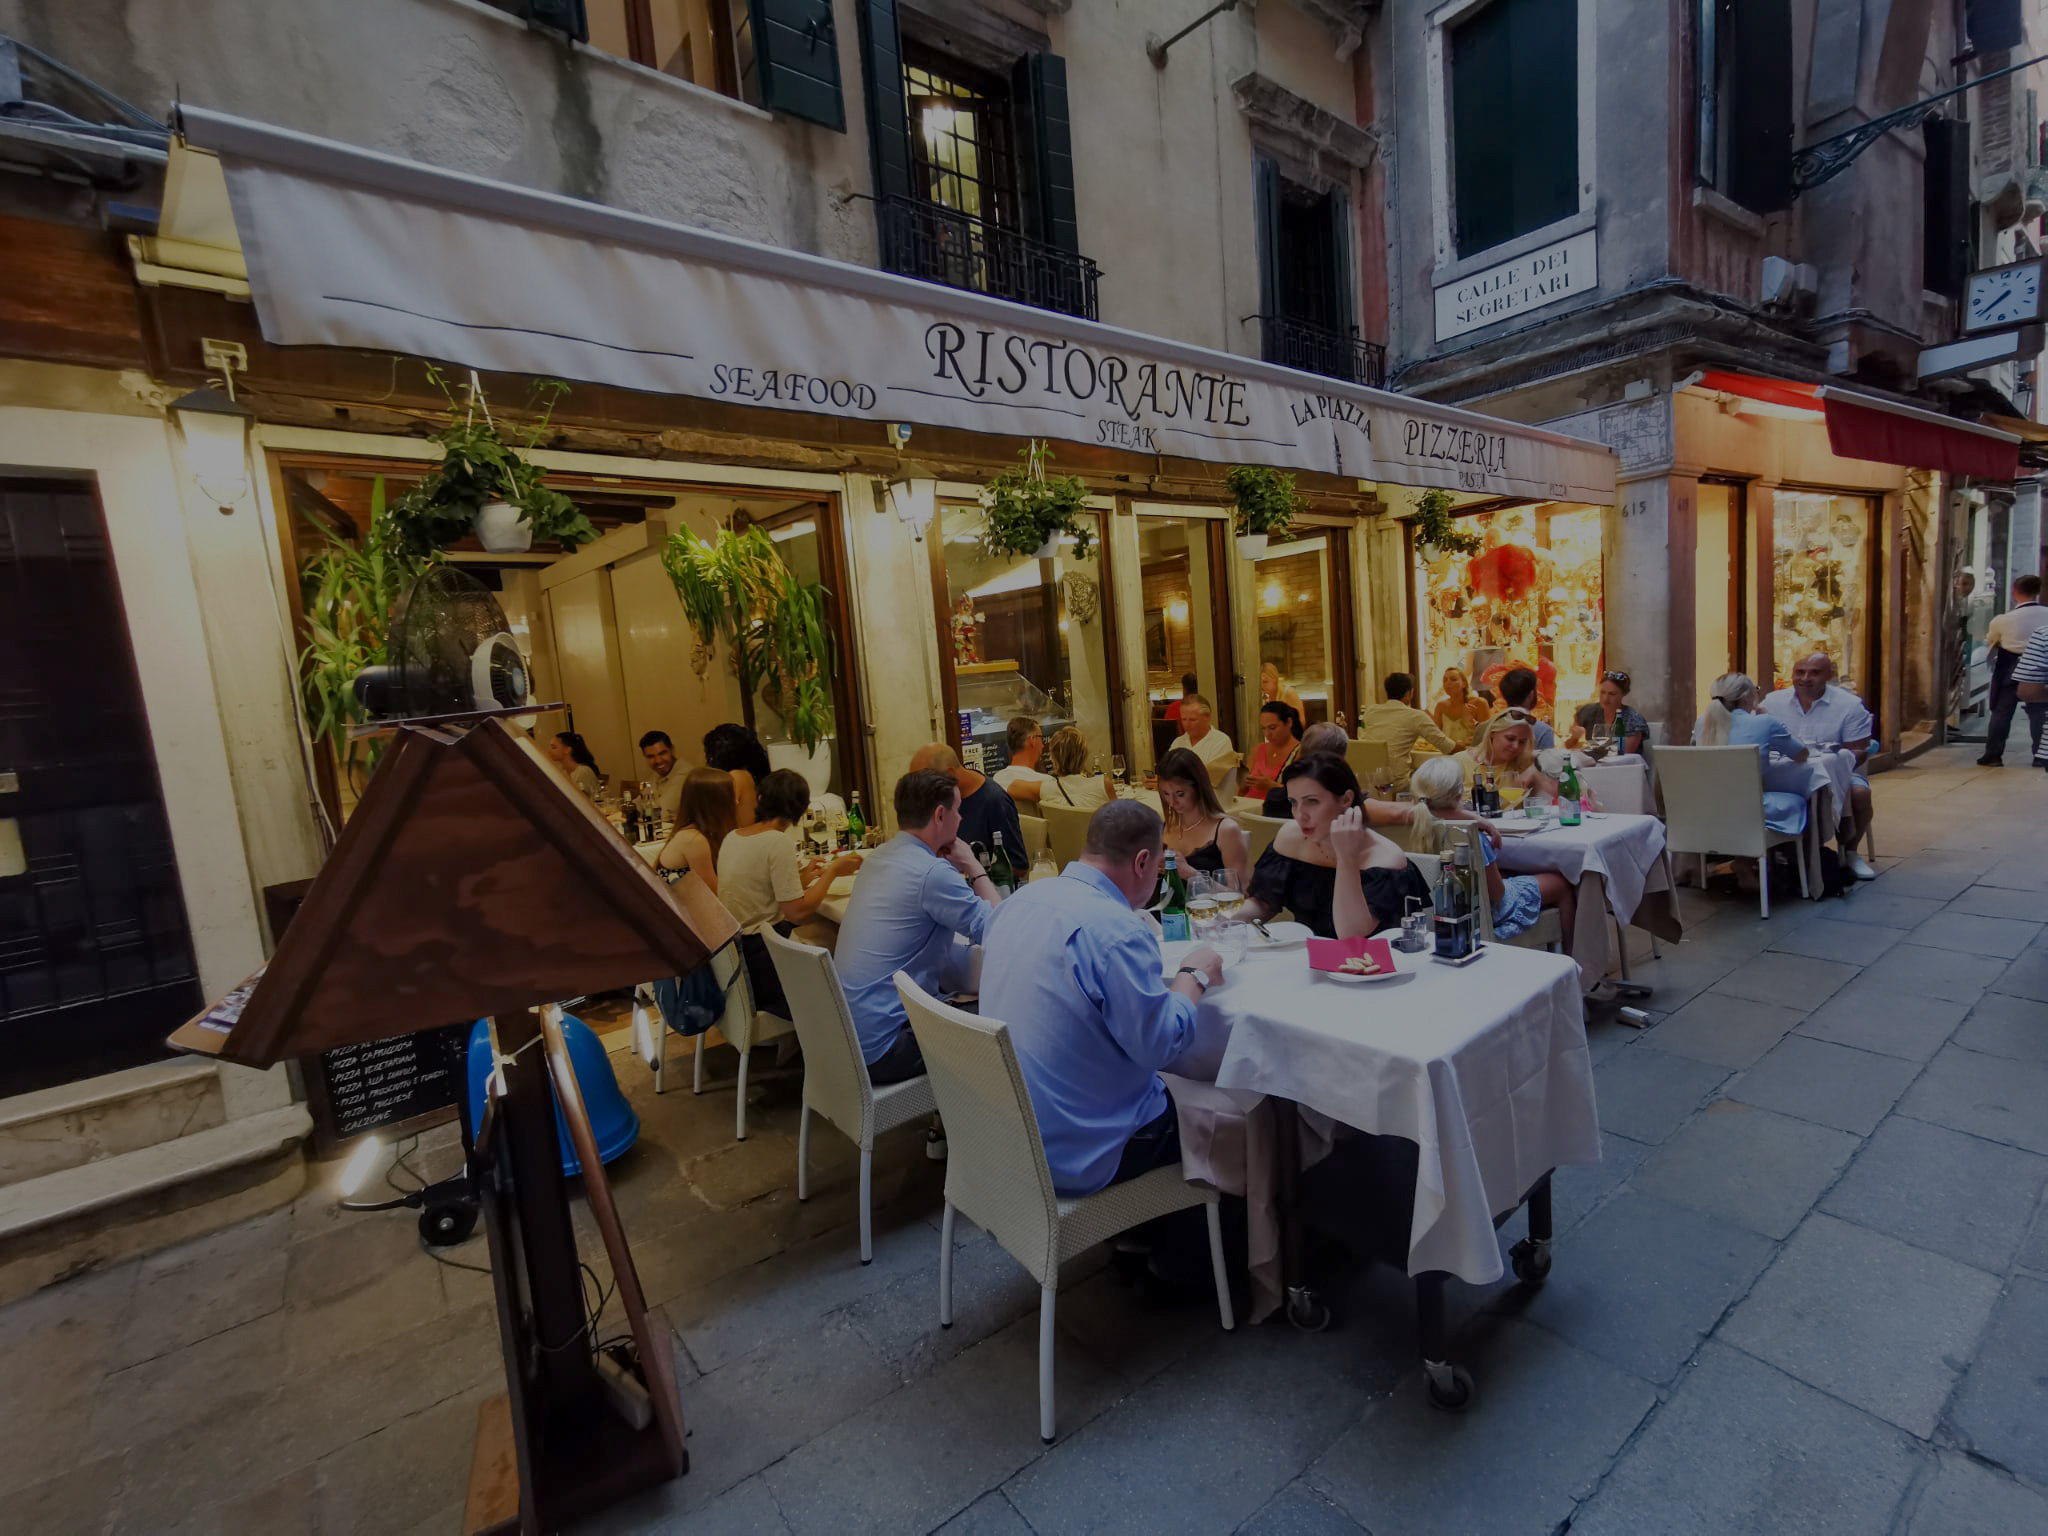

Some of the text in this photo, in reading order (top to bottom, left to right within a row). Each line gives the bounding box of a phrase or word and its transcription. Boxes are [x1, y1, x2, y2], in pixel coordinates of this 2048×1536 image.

[1456, 273, 1570, 326] SEGRETARI
[1457, 250, 1568, 303] CALLE DEI
[710, 363, 876, 411] SEAFOOD
[925, 322, 1250, 427] RISTORANTE
[1096, 420, 1162, 453] STEAK
[1290, 395, 1372, 441] LA PIAZZA
[1403, 419, 1508, 474] PIZZERIA
[1458, 471, 1486, 489] PASTA
[334, 1068, 361, 1083] PIZZA
[344, 1109, 393, 1132] CALZONE
